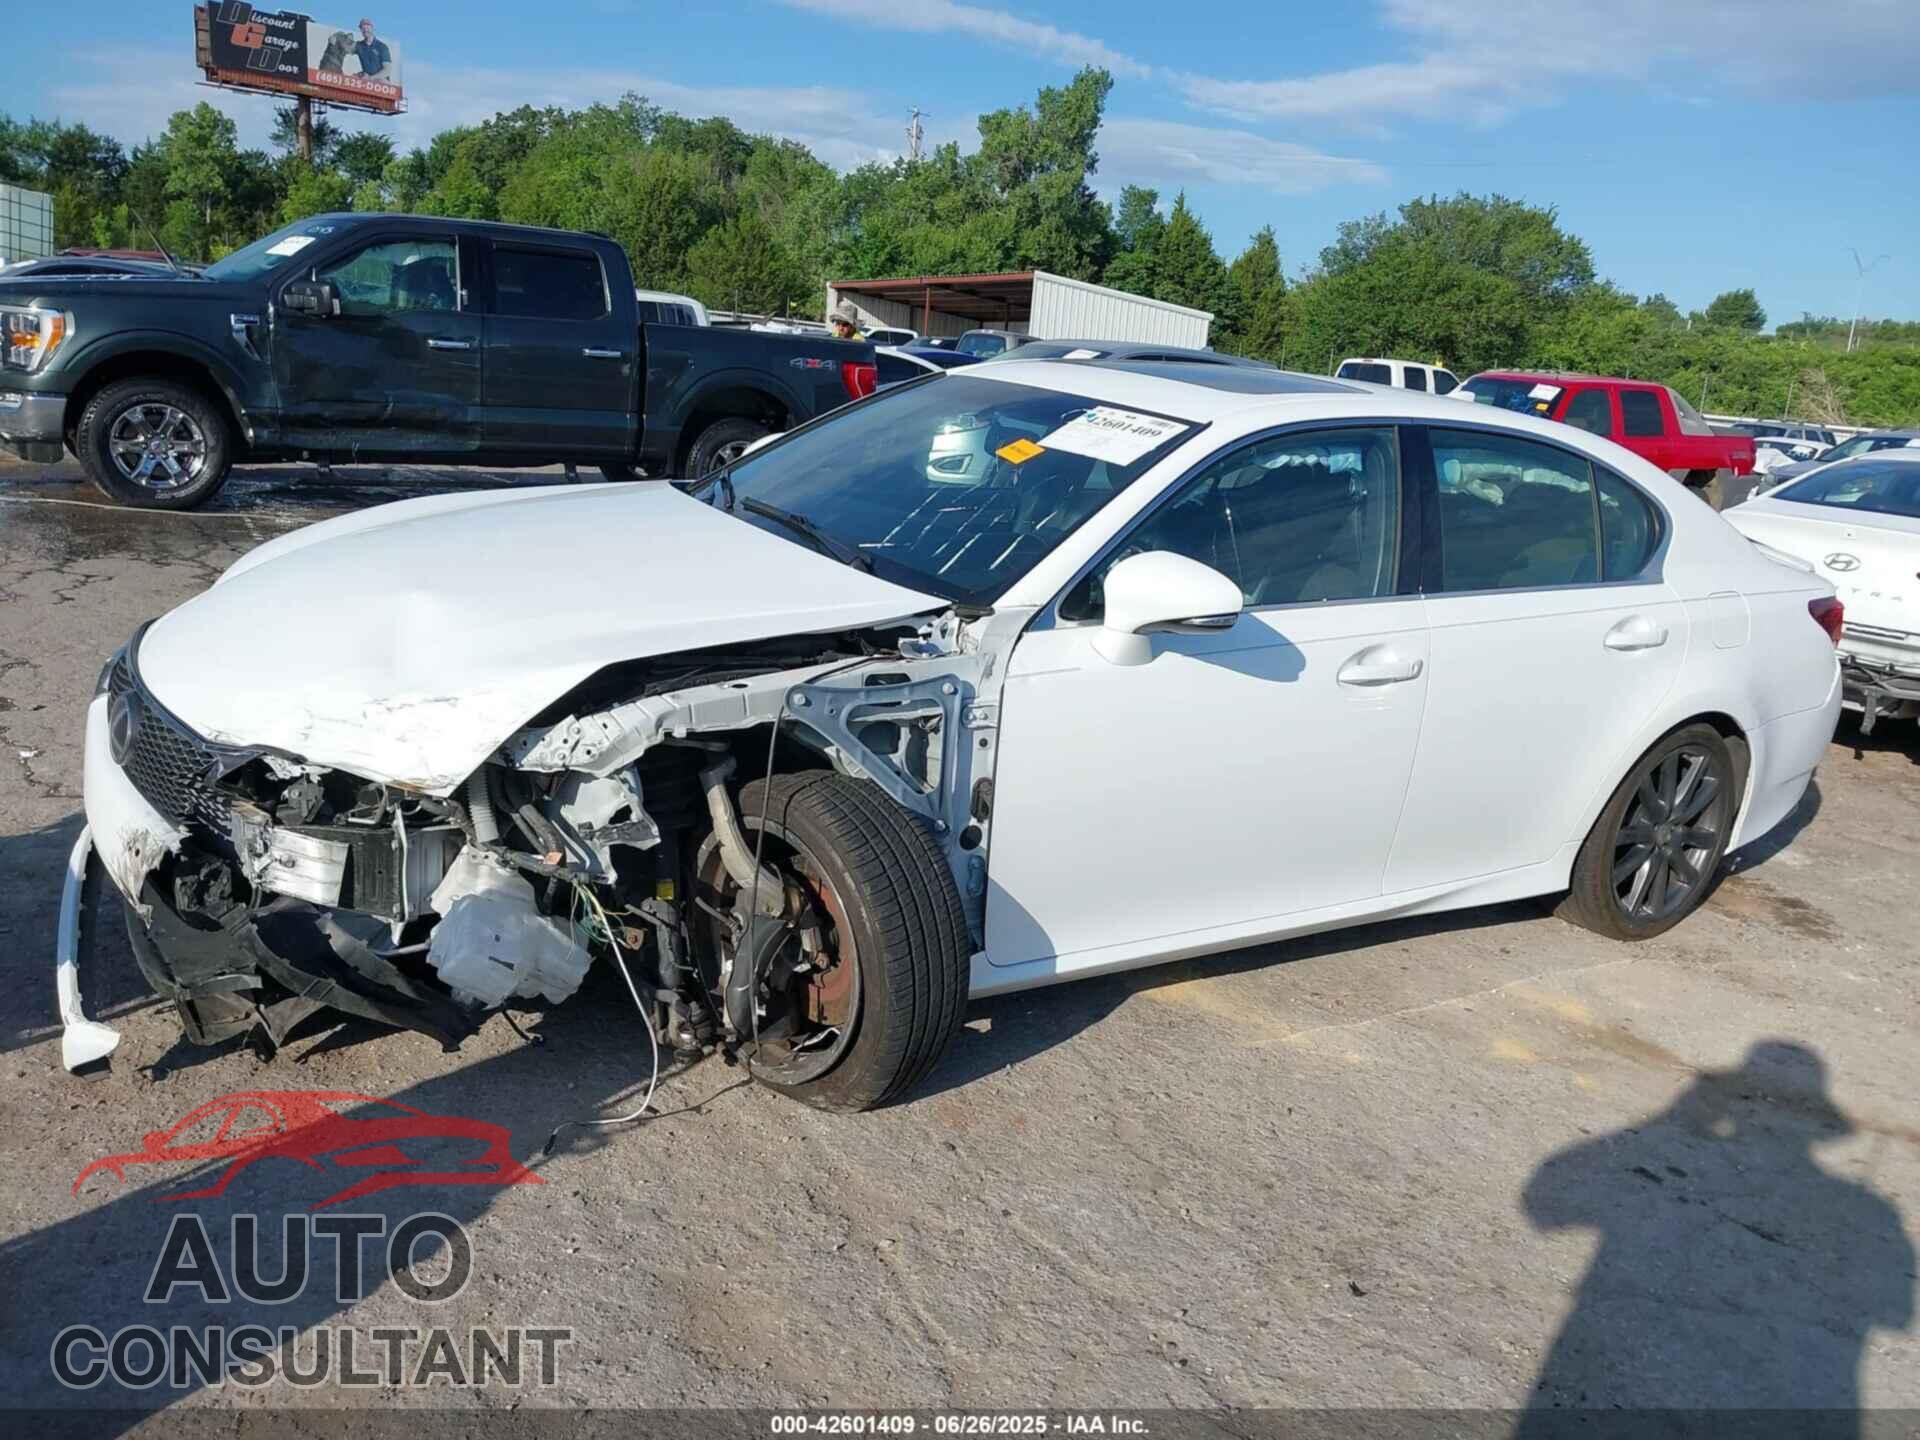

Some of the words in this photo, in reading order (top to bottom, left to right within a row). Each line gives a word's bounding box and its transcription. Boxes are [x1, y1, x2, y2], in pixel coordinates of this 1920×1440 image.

[216, 0, 296, 29] Discount
[231, 22, 299, 51] Garage
[246, 45, 299, 73] Door
